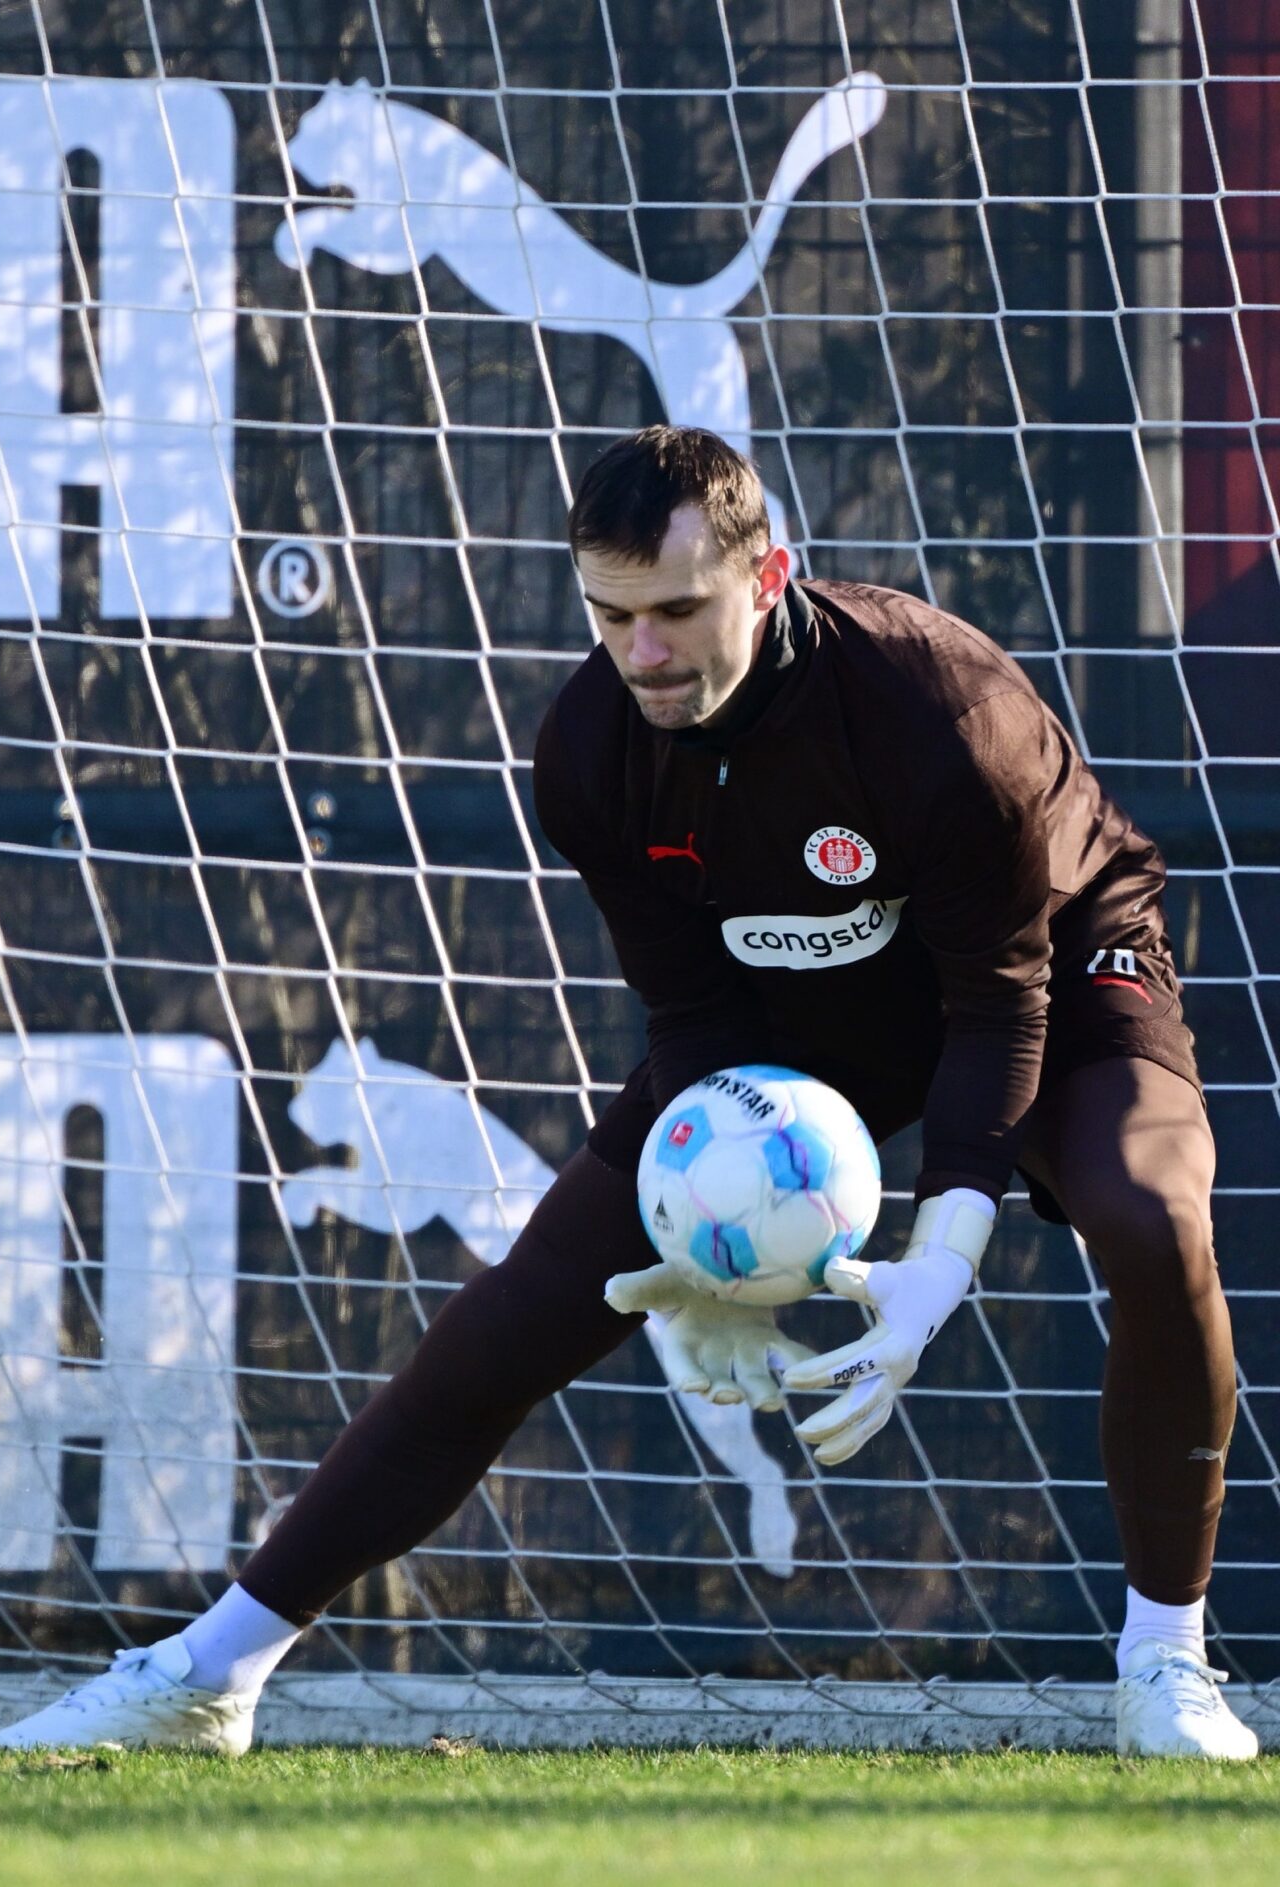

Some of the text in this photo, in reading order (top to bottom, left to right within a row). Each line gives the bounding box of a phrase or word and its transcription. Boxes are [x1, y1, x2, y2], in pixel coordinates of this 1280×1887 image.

[807, 841, 819, 853] FC
[839, 829, 873, 857] PAULI
[828, 874, 857, 883] 1910
